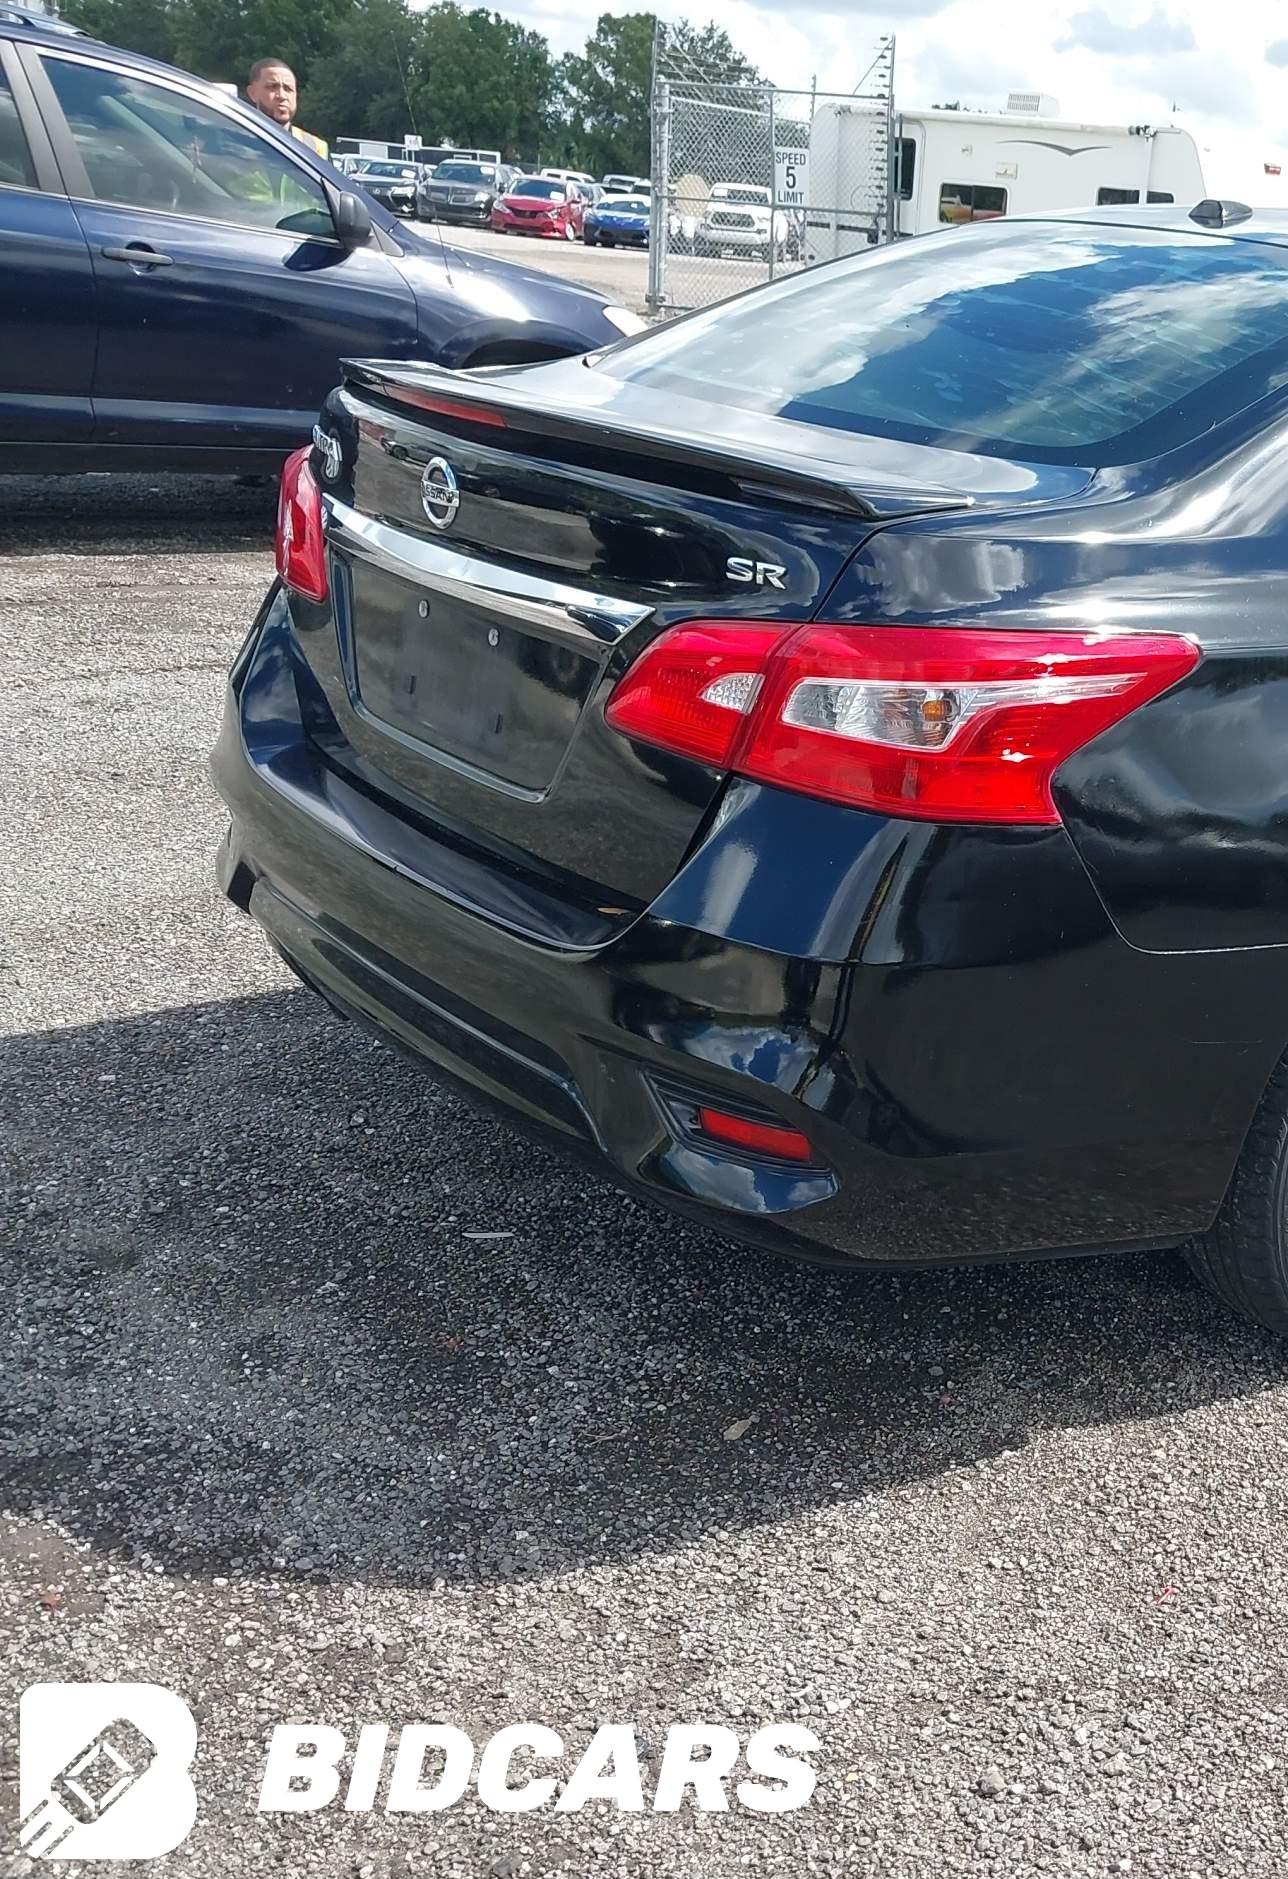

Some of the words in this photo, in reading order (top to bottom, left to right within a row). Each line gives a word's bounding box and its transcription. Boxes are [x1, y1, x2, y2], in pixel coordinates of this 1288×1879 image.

[775, 151, 807, 166] SPEED
[786, 165, 797, 189] 5
[777, 191, 805, 205] LIMIT
[726, 557, 787, 590] SR
